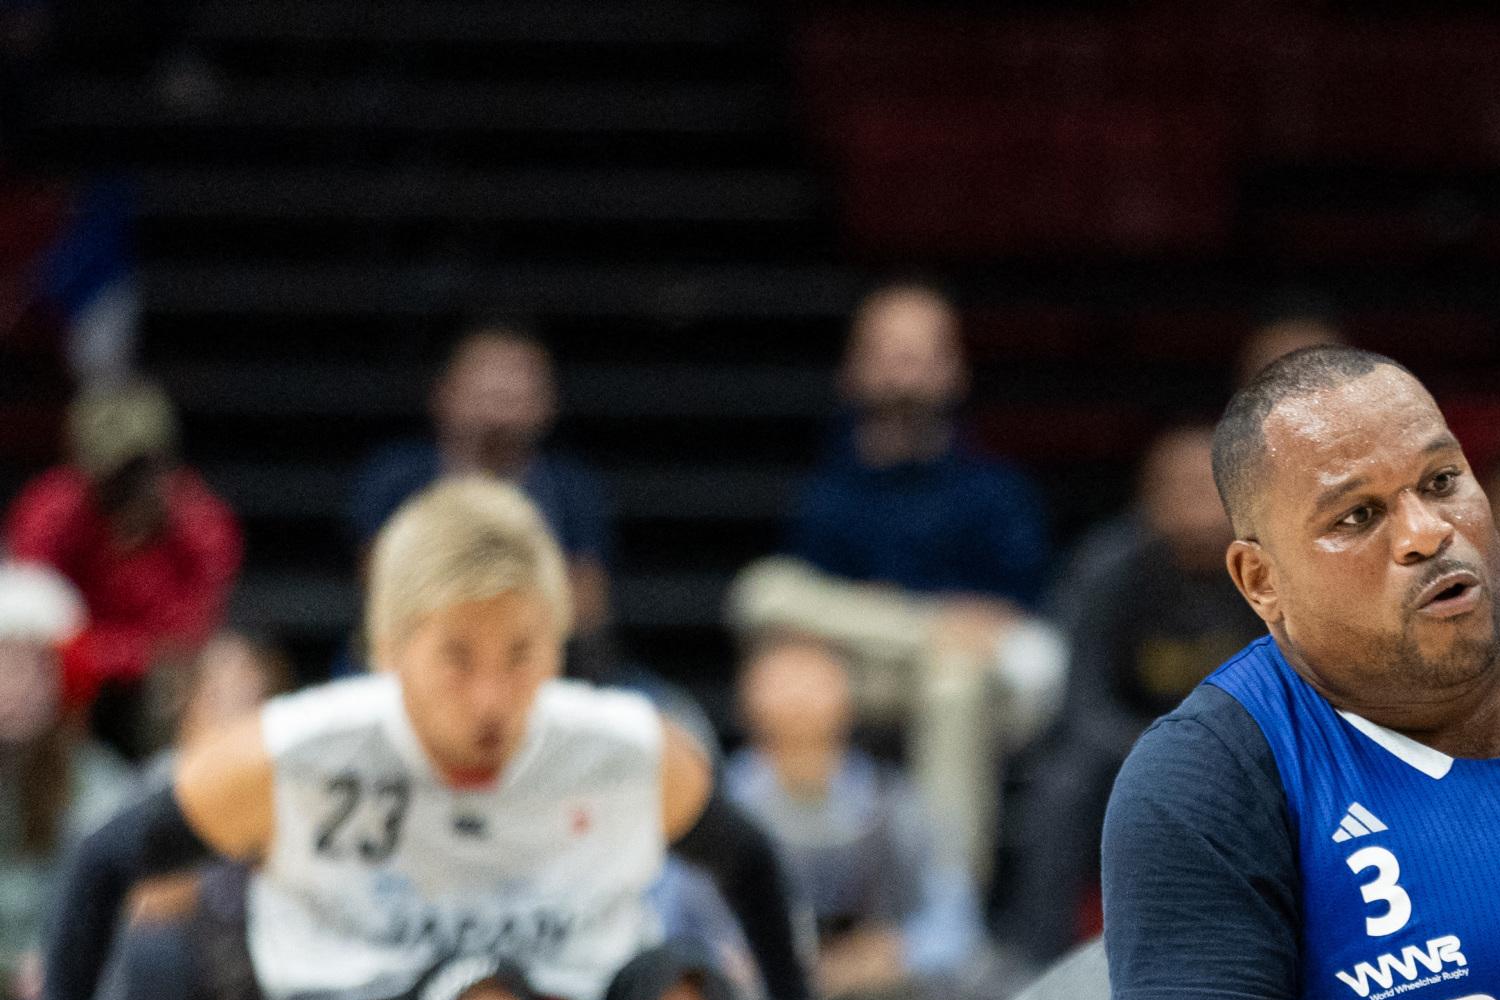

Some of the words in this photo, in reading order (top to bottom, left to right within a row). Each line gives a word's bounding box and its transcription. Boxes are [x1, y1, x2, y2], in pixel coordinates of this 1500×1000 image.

[312, 769, 414, 862] 23
[1346, 845, 1412, 938] 3
[1394, 974, 1443, 996] Wheelchair
[1442, 967, 1470, 982] Rugby
